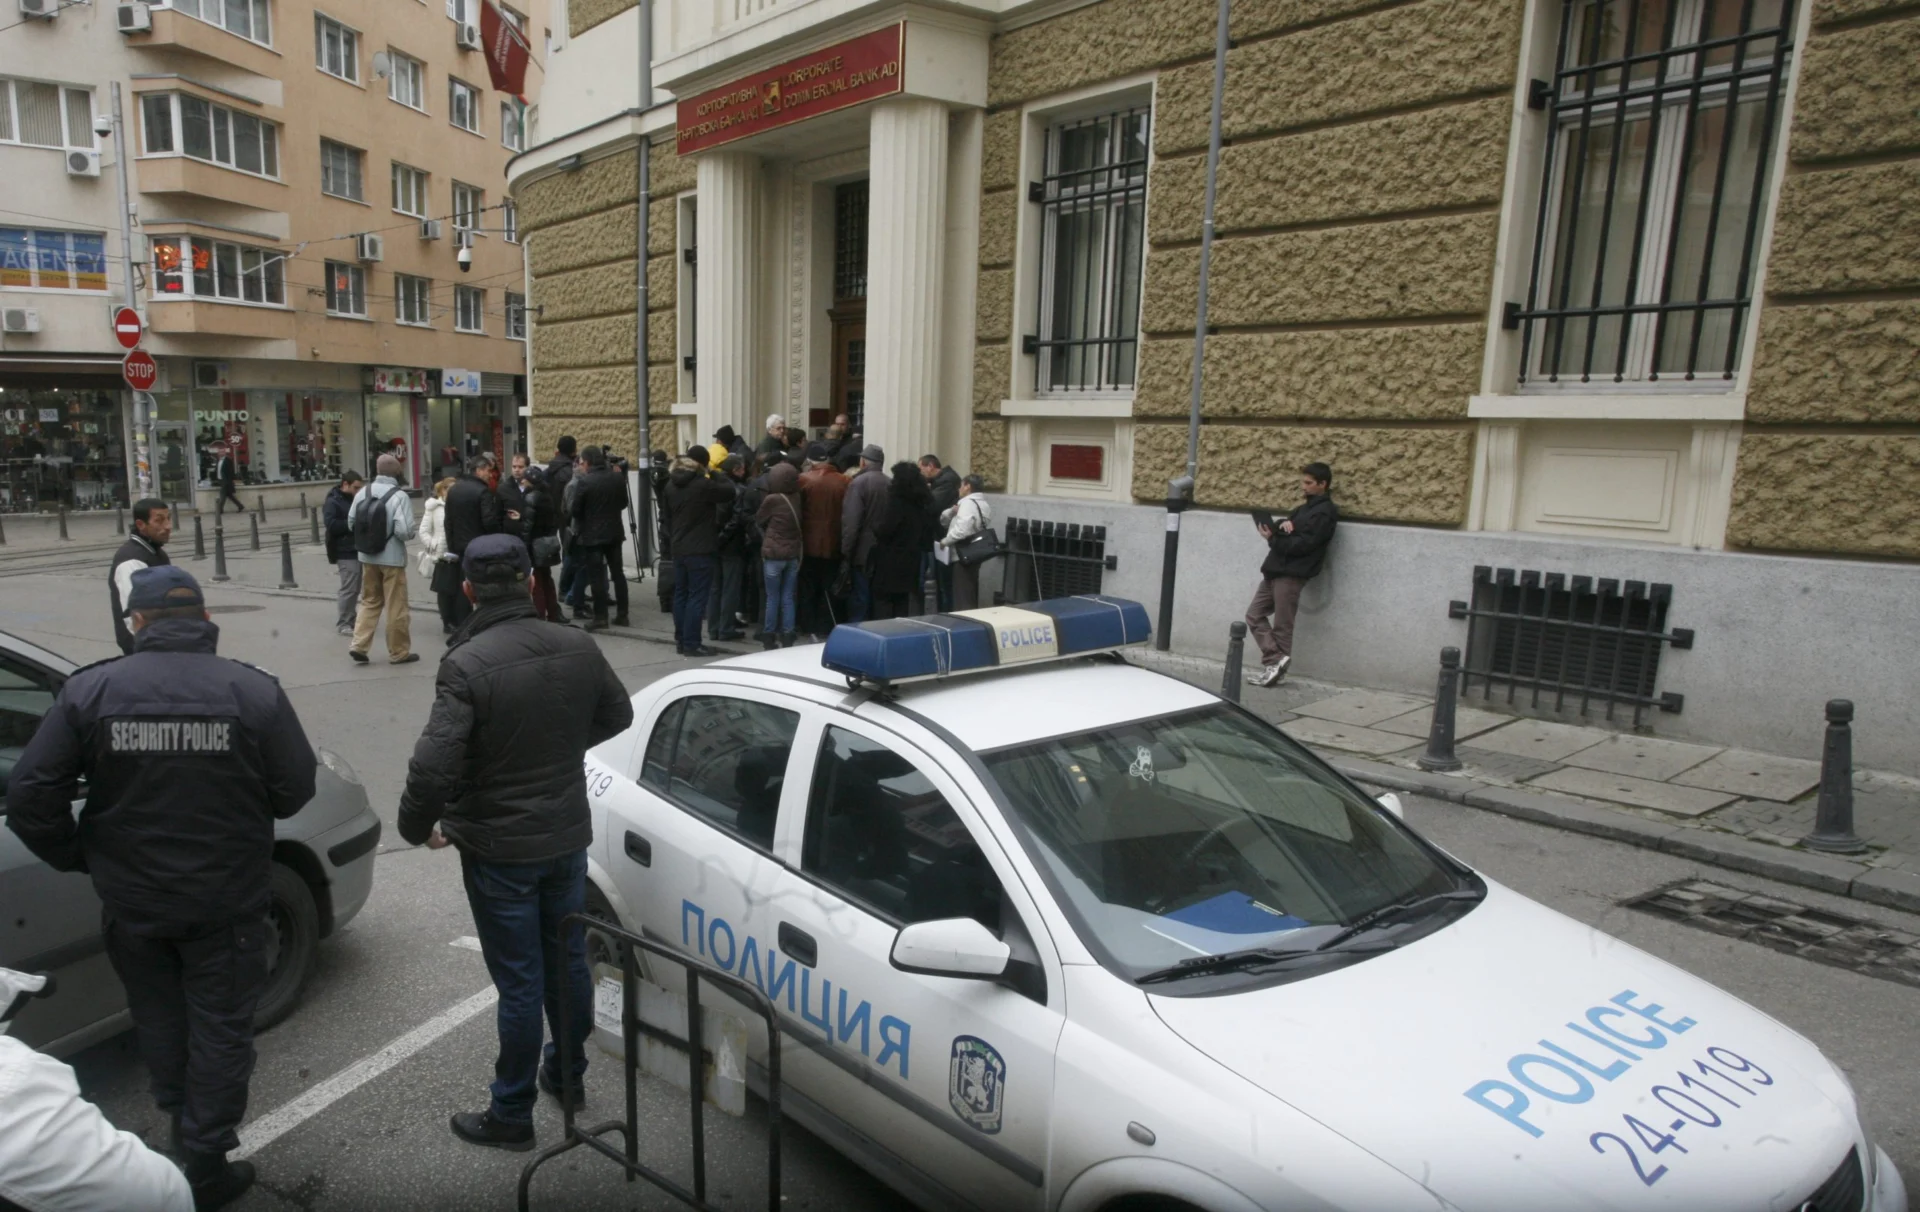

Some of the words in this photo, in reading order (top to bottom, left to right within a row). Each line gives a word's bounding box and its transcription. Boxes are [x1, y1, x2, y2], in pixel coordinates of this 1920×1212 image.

[783, 56, 842, 86] CORPORATE
[783, 77, 848, 108] COMMERCIAL
[850, 67, 879, 88] BANK
[881, 61, 898, 78] AD
[696, 85, 758, 117] КОРПОРАТИВНА
[3, 248, 102, 273] AGENCY
[127, 362, 154, 379] STOP
[194, 410, 250, 422] PUNTO
[1000, 626, 1053, 648] POLICE
[111, 721, 180, 751] SECURITY
[182, 722, 230, 751] POLICE
[681, 898, 912, 1080] ПОЛИЦИЯ
[1462, 989, 1698, 1139] POLICE
[1589, 1046, 1774, 1187] 24-0119
